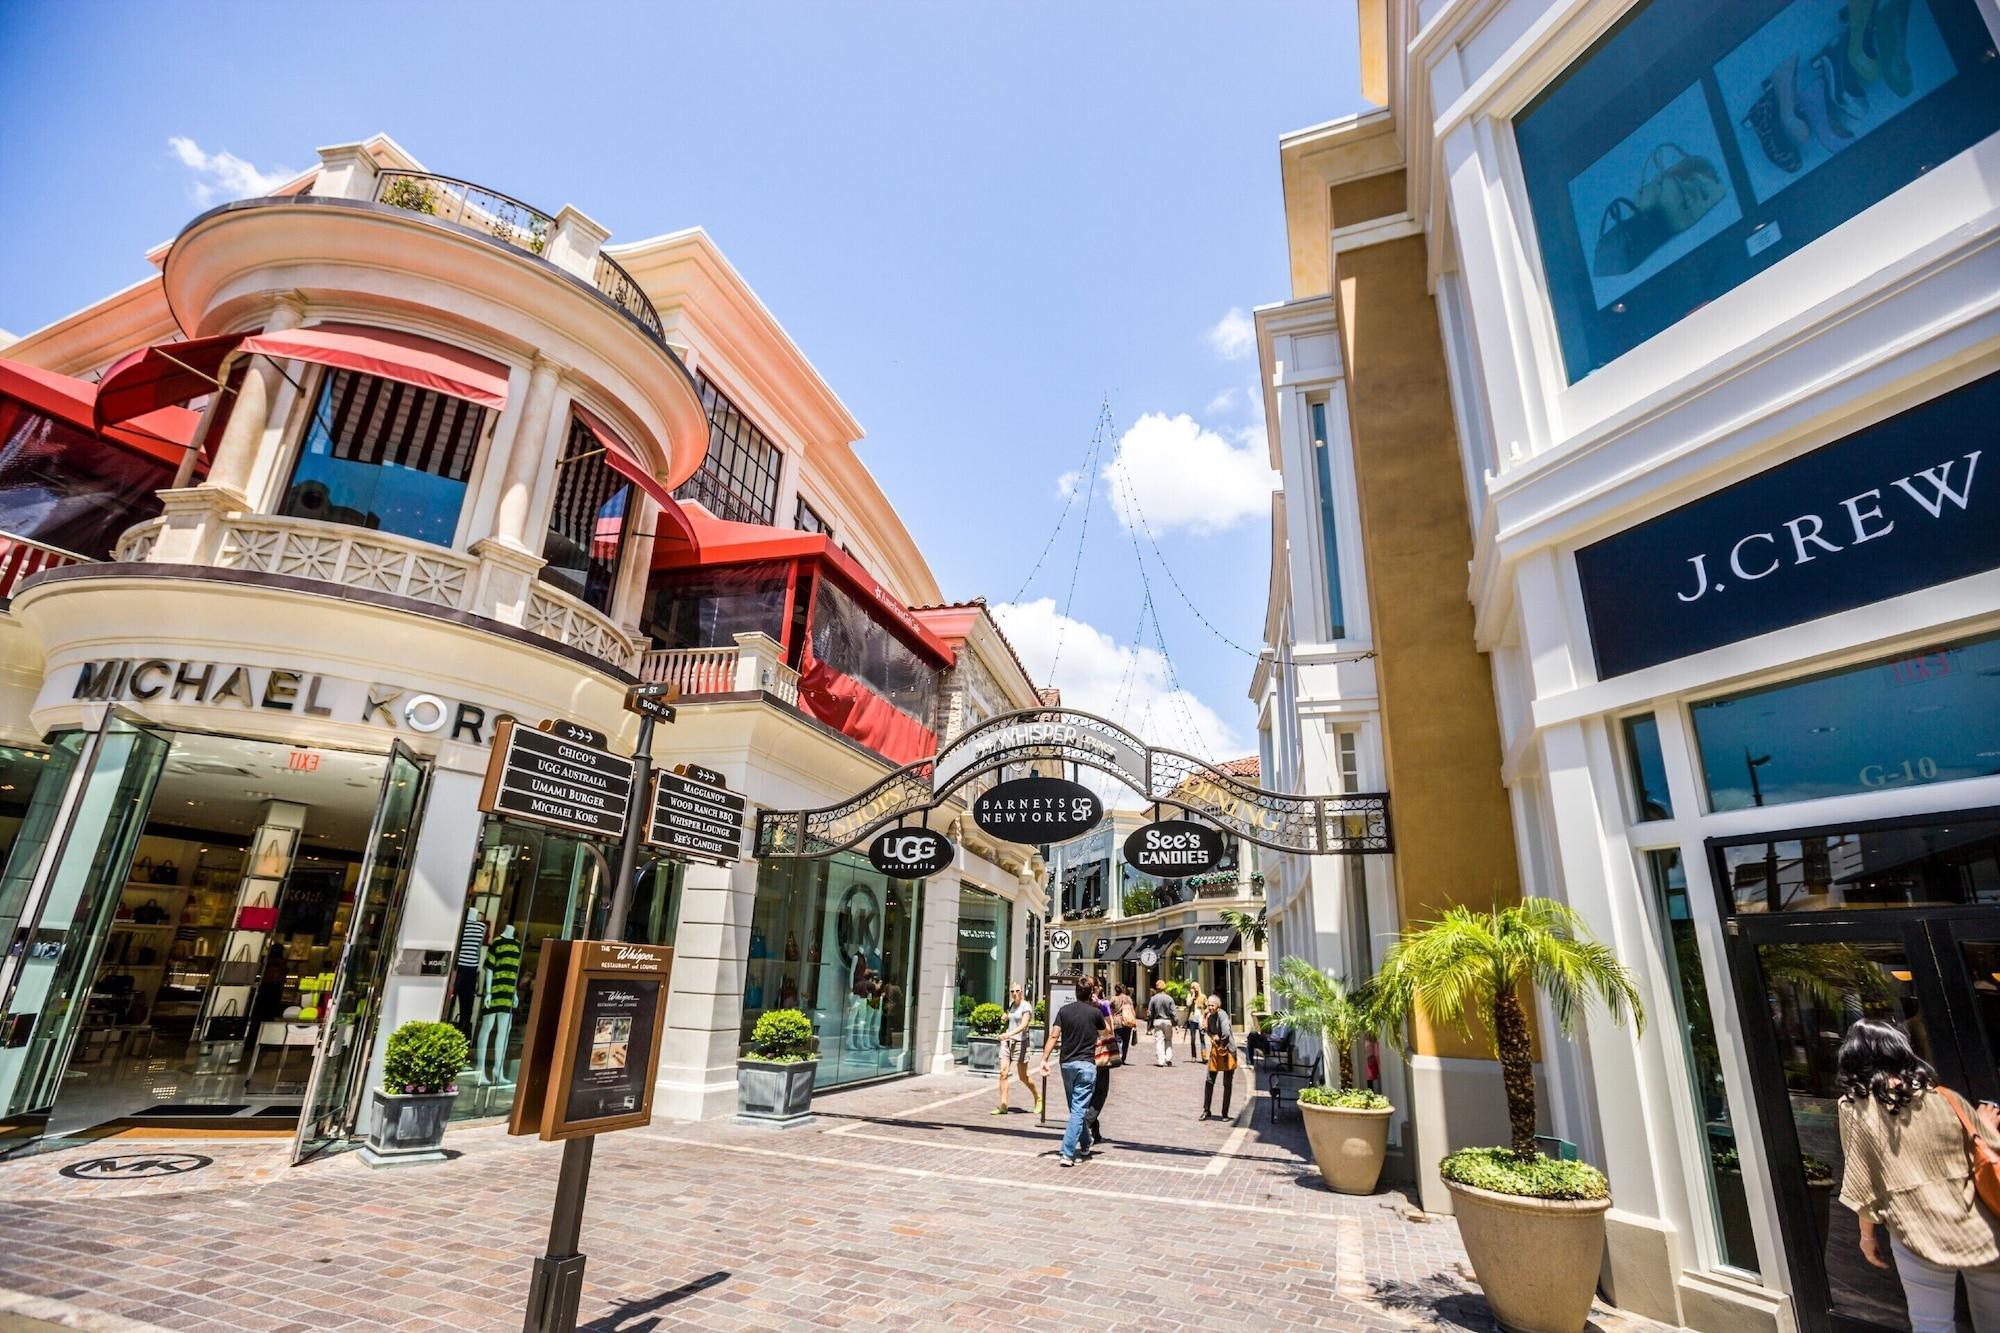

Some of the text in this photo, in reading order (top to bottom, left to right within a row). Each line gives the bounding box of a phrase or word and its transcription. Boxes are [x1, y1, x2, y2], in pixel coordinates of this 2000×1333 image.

[1677, 450, 1982, 602] J.CREW
[72, 659, 332, 717] MICHAEL
[649, 686, 658, 694] ST
[642, 699, 670, 717] BOW ST
[996, 722, 1077, 746] WHISPER
[558, 745, 597, 765] CHICO'S
[538, 759, 608, 788] UGG AUSTRALIA
[1860, 757, 1937, 787] G-10
[531, 779, 605, 808] UMAMI BURGER
[683, 783, 726, 803] MAGGIANO'S
[982, 798, 1066, 811] BARNEYS
[1180, 773, 1280, 831] DINING
[531, 800, 599, 824] MICHAEL KORS
[670, 796, 734, 825] WOOD RANCH BBQ
[834, 790, 901, 836] SHOPS
[670, 814, 730, 837] WHISPER LOUNGE
[674, 833, 722, 852] SEE'S CANDIES
[883, 836, 937, 864] UGG
[1146, 830, 1200, 850] See's
[1138, 850, 1209, 865] CANDIES
[612, 945, 662, 964] Whisper
[605, 990, 640, 1003] Whisper
